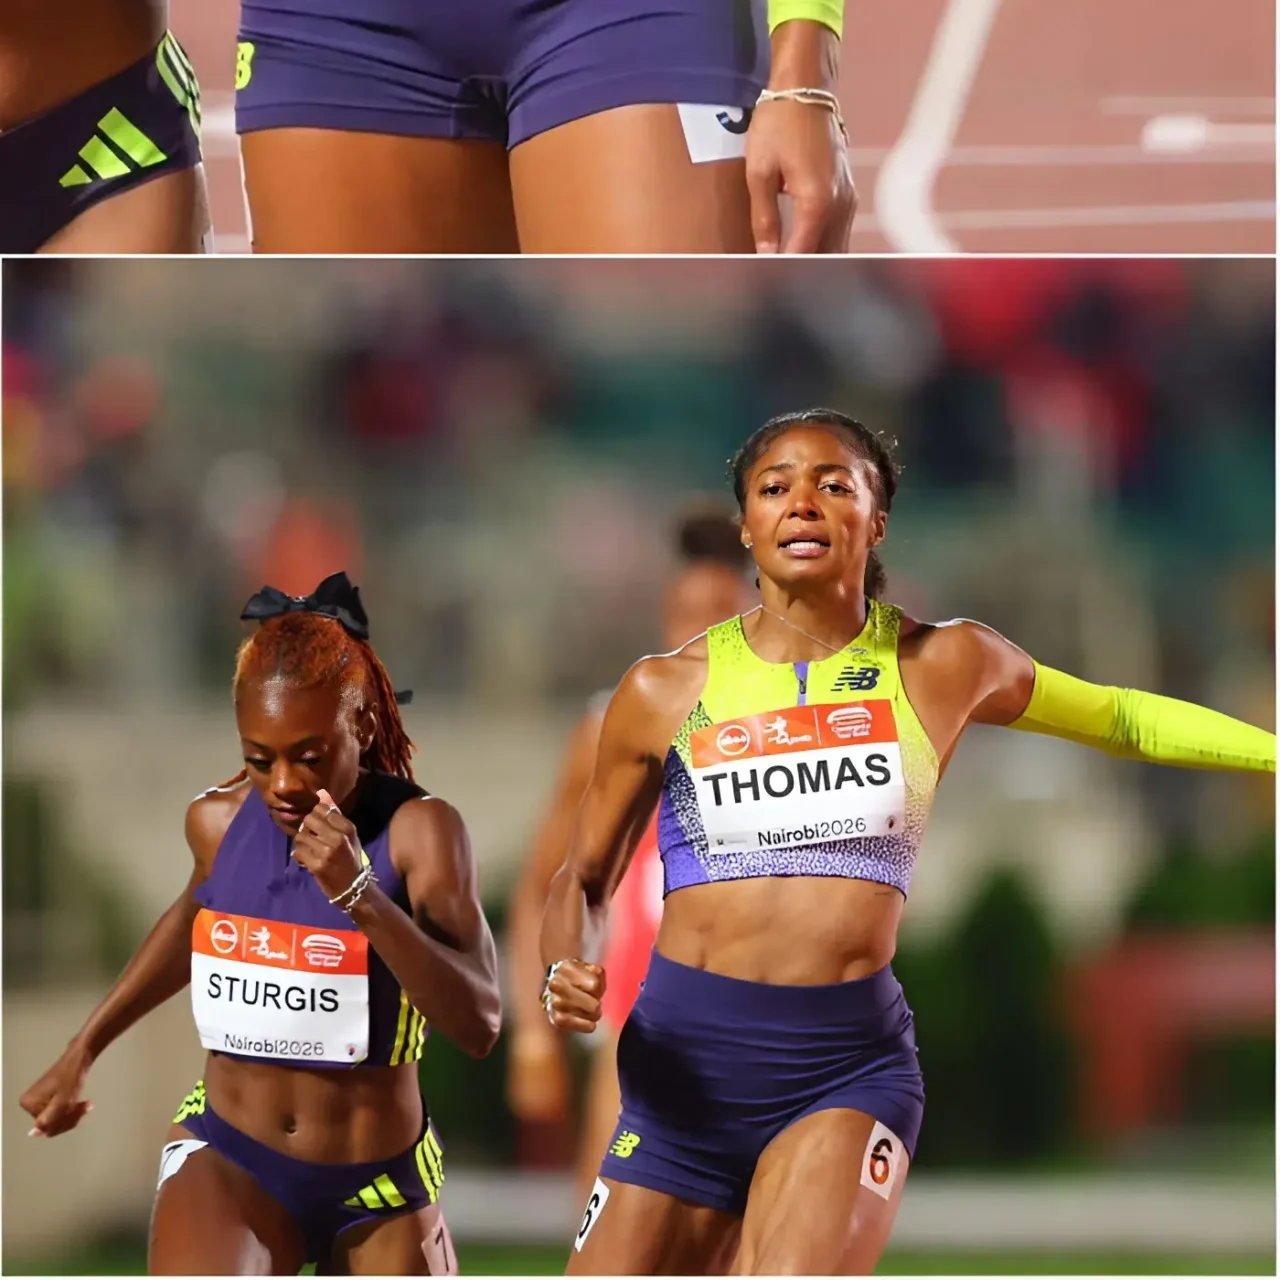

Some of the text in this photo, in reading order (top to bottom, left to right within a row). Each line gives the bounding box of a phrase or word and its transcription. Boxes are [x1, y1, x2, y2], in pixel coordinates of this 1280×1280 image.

[702, 753, 892, 807] THOMAS
[757, 817, 867, 846] Nairobi2026
[207, 973, 339, 1012] STURGIS
[224, 1033, 324, 1057] Nairobi2026
[869, 1137, 893, 1186] 6
